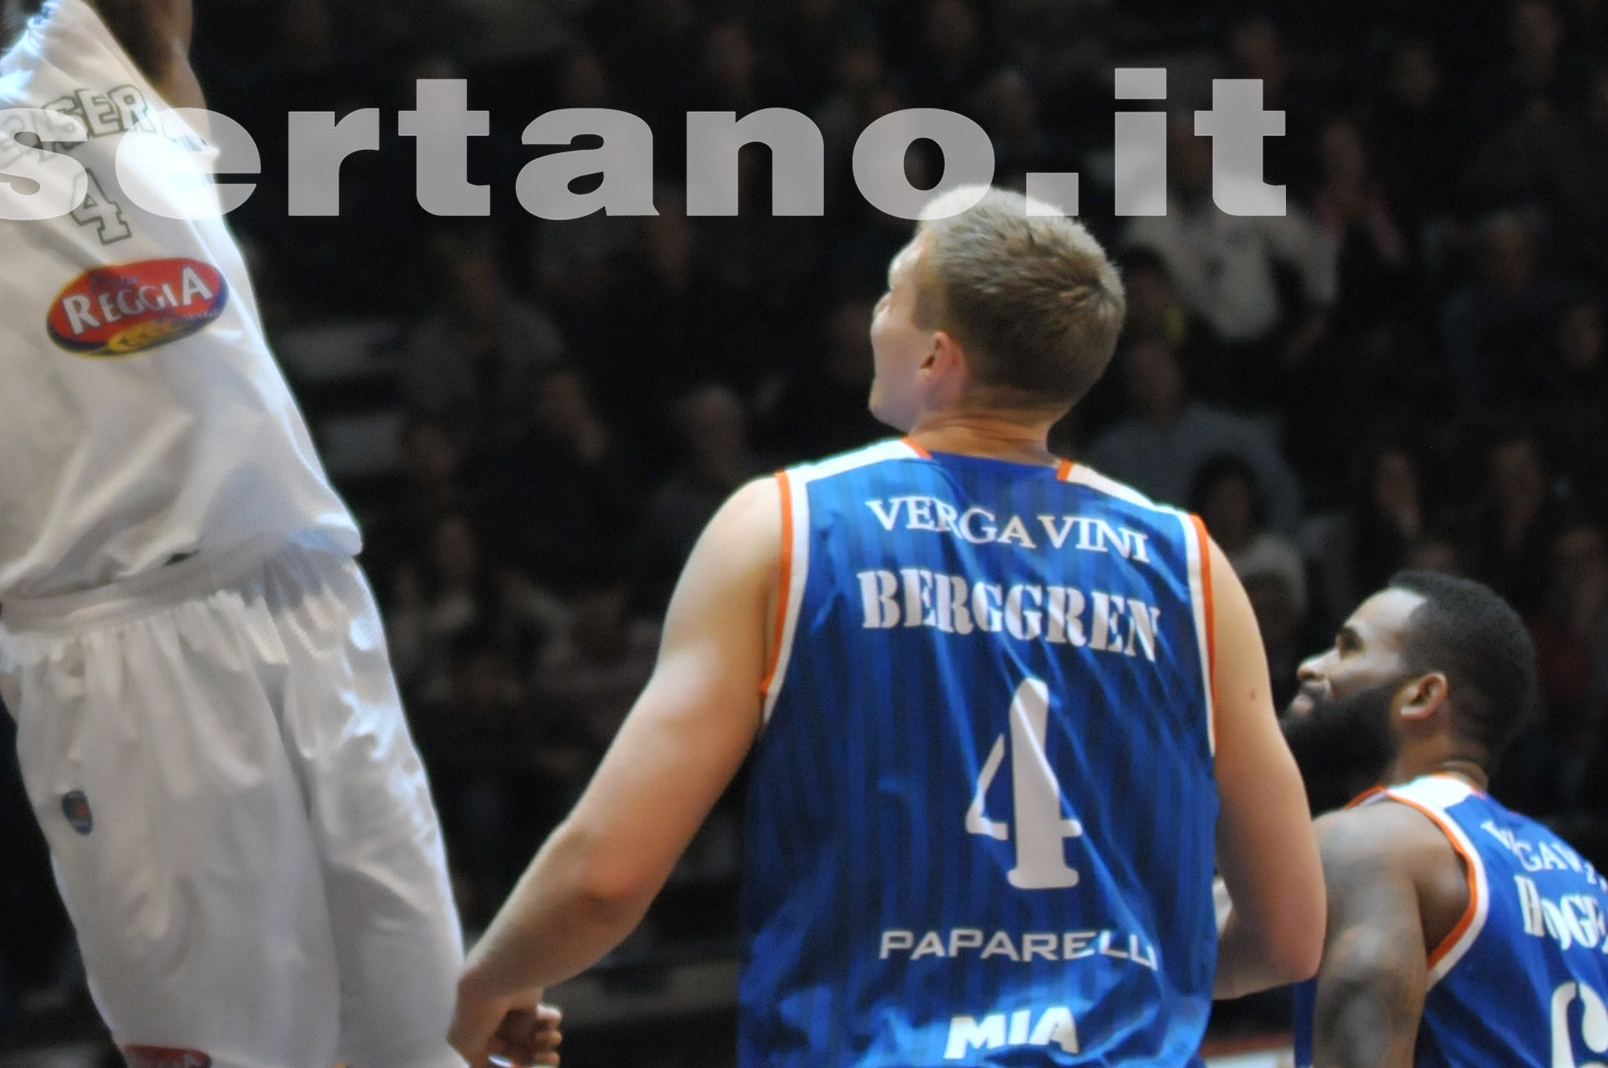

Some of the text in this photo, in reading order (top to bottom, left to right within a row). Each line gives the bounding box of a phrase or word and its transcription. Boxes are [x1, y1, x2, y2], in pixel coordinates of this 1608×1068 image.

[69, 164, 132, 245] 4
[62, 266, 213, 335] REGGIA
[856, 568, 1161, 663] BERGGREN
[965, 676, 1083, 890] 4
[943, 1006, 1080, 1060] MIA
